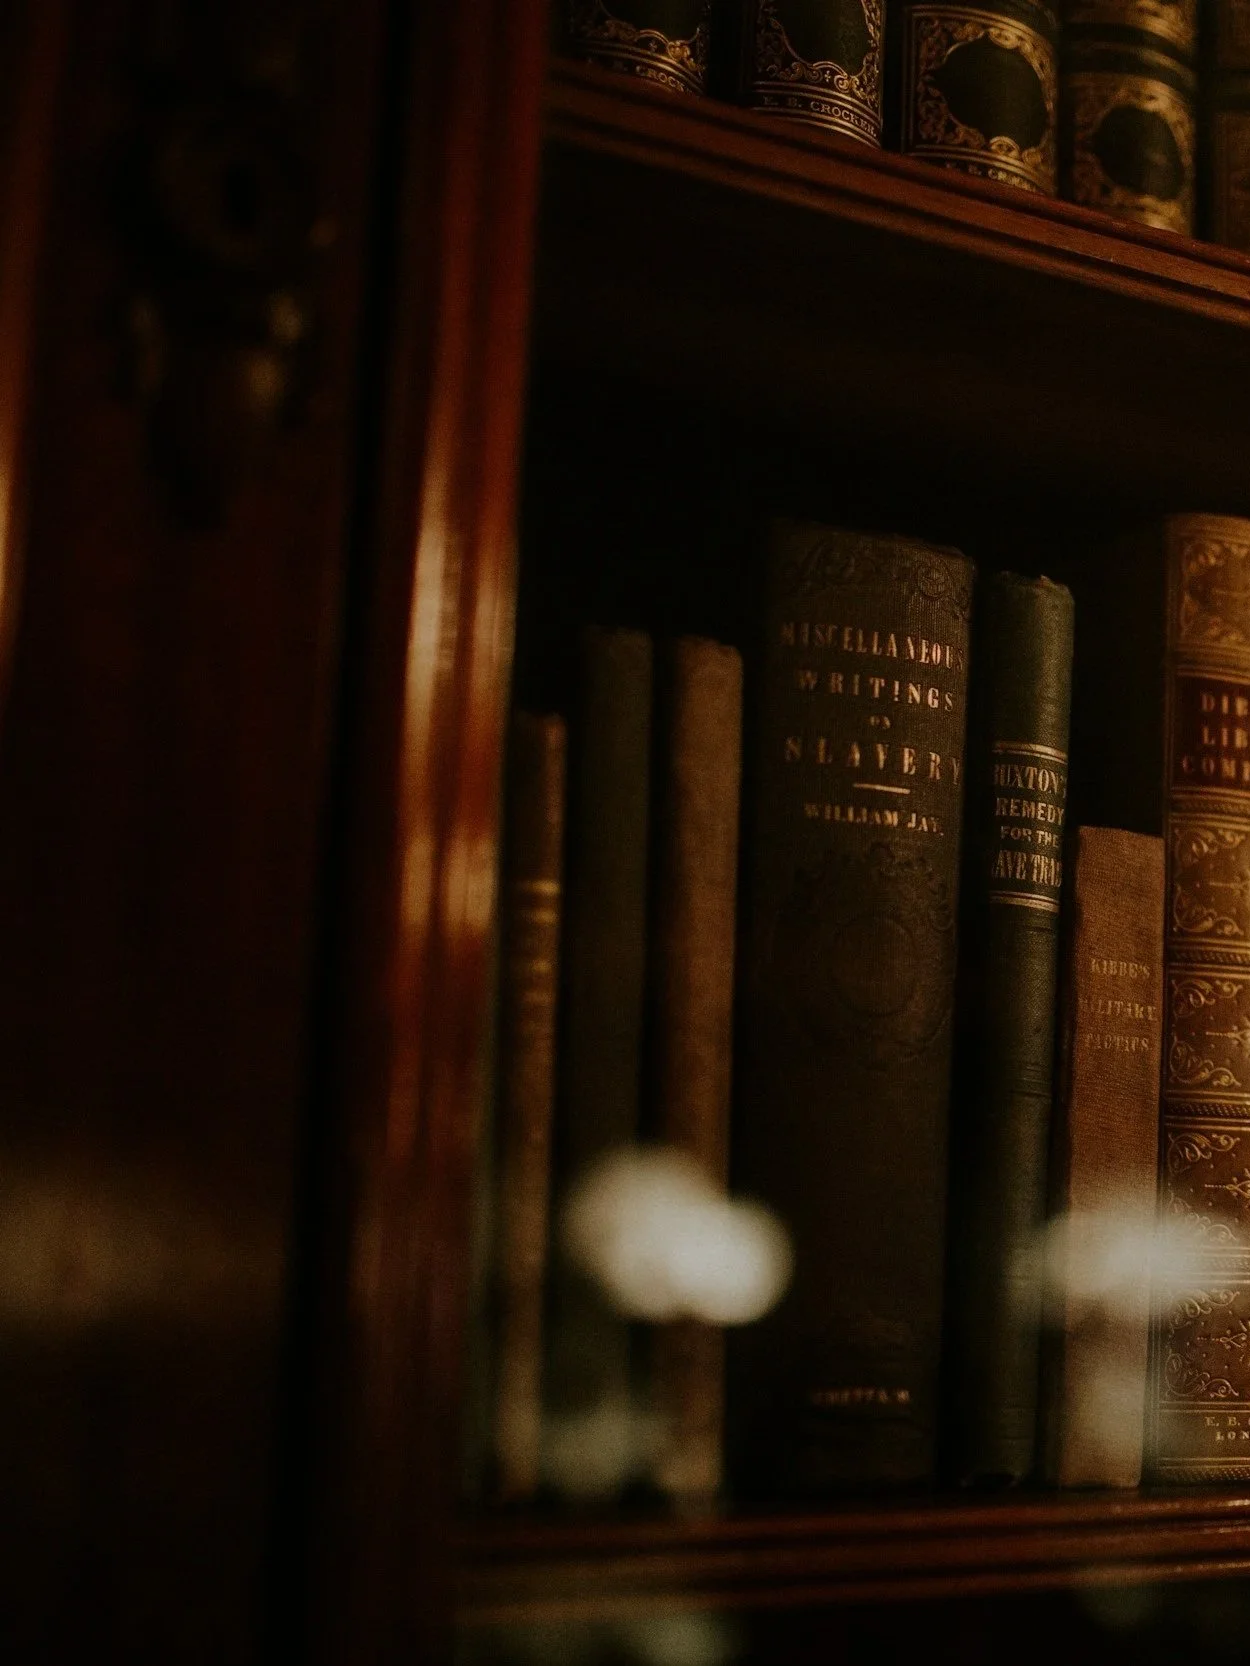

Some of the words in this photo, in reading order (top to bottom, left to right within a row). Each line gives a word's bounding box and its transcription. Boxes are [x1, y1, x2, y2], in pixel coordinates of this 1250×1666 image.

[780, 621, 965, 671] MISCELLANEOUS
[796, 668, 954, 712] WRITINGS
[784, 735, 961, 786] SLAVERY
[995, 797, 1065, 826] REMEDY
[1000, 825, 1033, 843] FOR
[1036, 830, 1061, 849] THE
[1204, 1416, 1221, 1428] E.
[1227, 1416, 1242, 1427] B.
